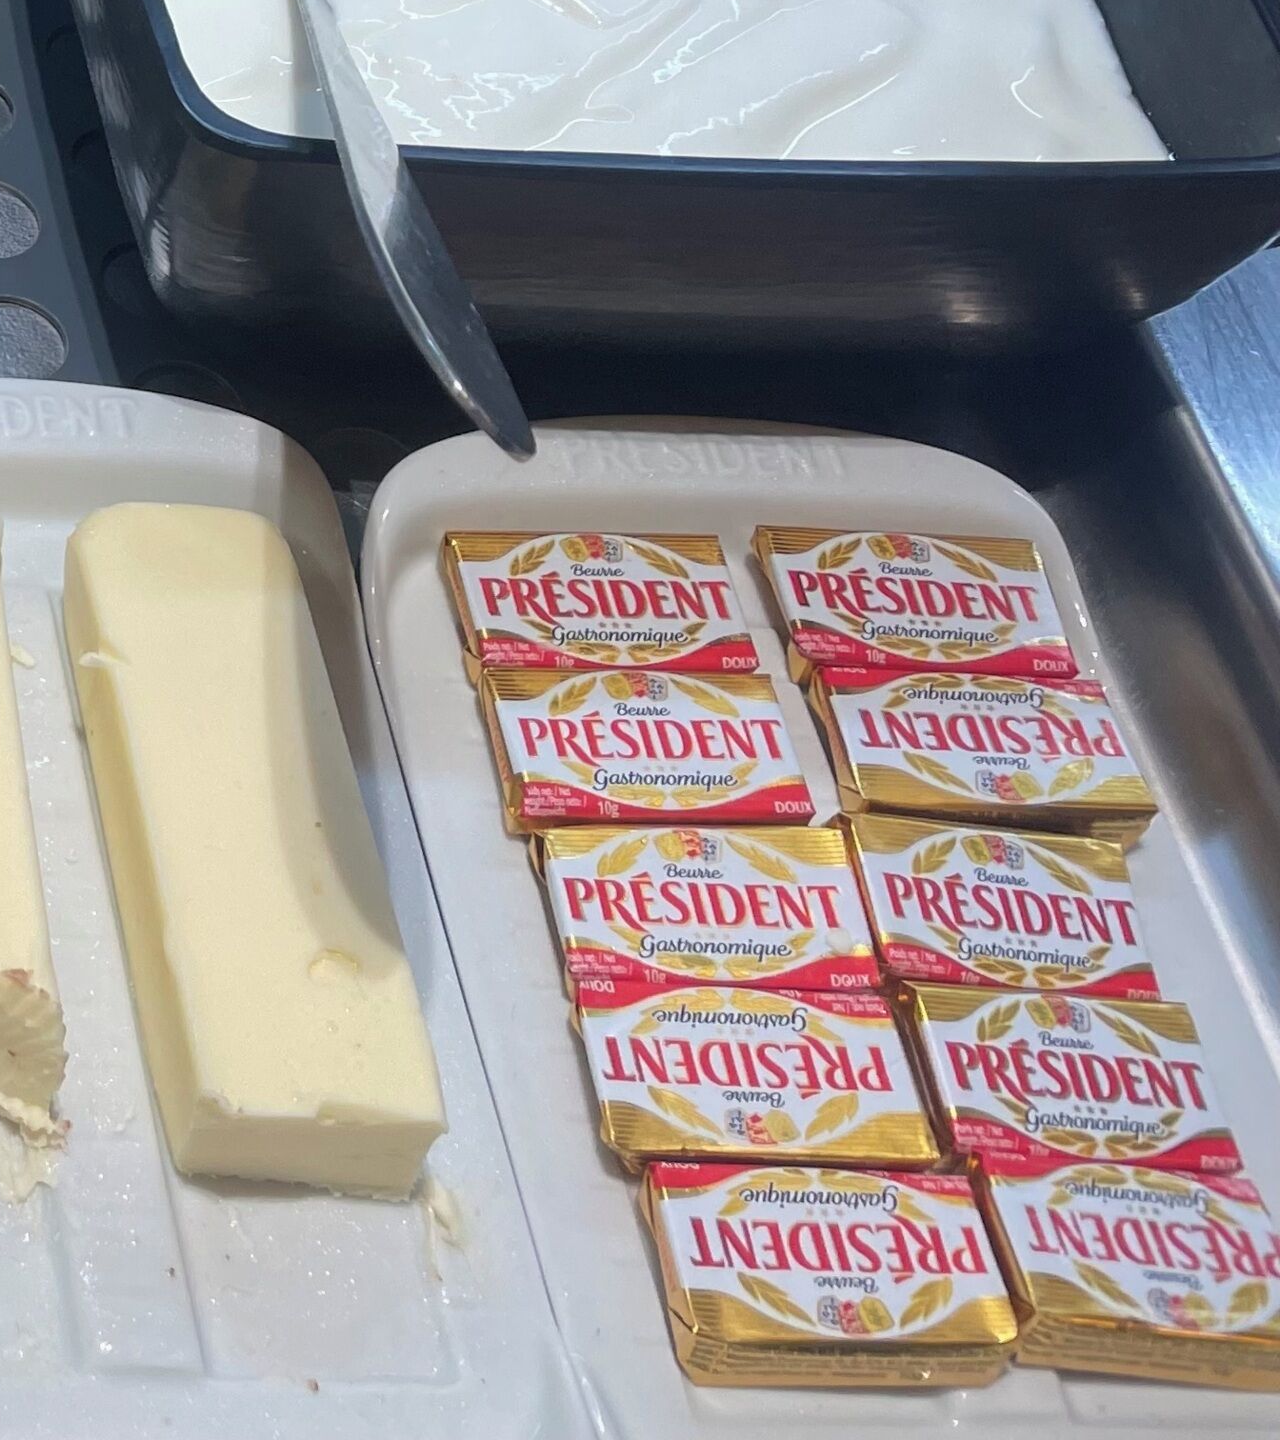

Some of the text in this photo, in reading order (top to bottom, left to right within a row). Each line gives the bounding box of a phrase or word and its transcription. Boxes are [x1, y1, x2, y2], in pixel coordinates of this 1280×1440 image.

[570, 563, 624, 578] Beurre
[878, 561, 933, 577] Beurre
[478, 571, 731, 625] PRÉSIDENT
[788, 567, 1039, 624] PRÉSIDENT
[552, 625, 689, 647] Gastronomique
[860, 620, 999, 647] Gastronomique
[722, 656, 758, 670] DOUX
[1033, 659, 1069, 672] DOUX
[904, 685, 1044, 709] Gastronomique
[614, 703, 670, 718] Beurre
[517, 711, 783, 768] PRÉSIDENT
[861, 707, 1126, 763] PRÉSIDENT
[973, 755, 1032, 770] Beurre
[592, 768, 739, 793] Gastronomique
[598, 800, 620, 819] 10g
[774, 801, 812, 815] DOUX
[664, 863, 724, 880] Beurre
[974, 867, 1030, 888] Beurre
[563, 871, 840, 933] PRÉSIDENT
[883, 871, 1138, 947] PRÉSIDENT
[639, 934, 793, 962] Gastronomique
[957, 936, 1096, 970] Gastronomique
[652, 1008, 808, 1031] Gastronomique
[1039, 1030, 1095, 1051] Beurre
[602, 1035, 894, 1100] PRÉSIDENT
[945, 1038, 1208, 1112] PRÉSIDENT
[722, 1089, 785, 1107] Beurre
[1025, 1106, 1166, 1140] Gastronomique
[739, 1184, 899, 1212] Gastronomique
[1065, 1180, 1210, 1217] Gastronomique
[689, 1215, 988, 1284] PRÉSIDENT
[813, 1276, 879, 1293] Beurre
